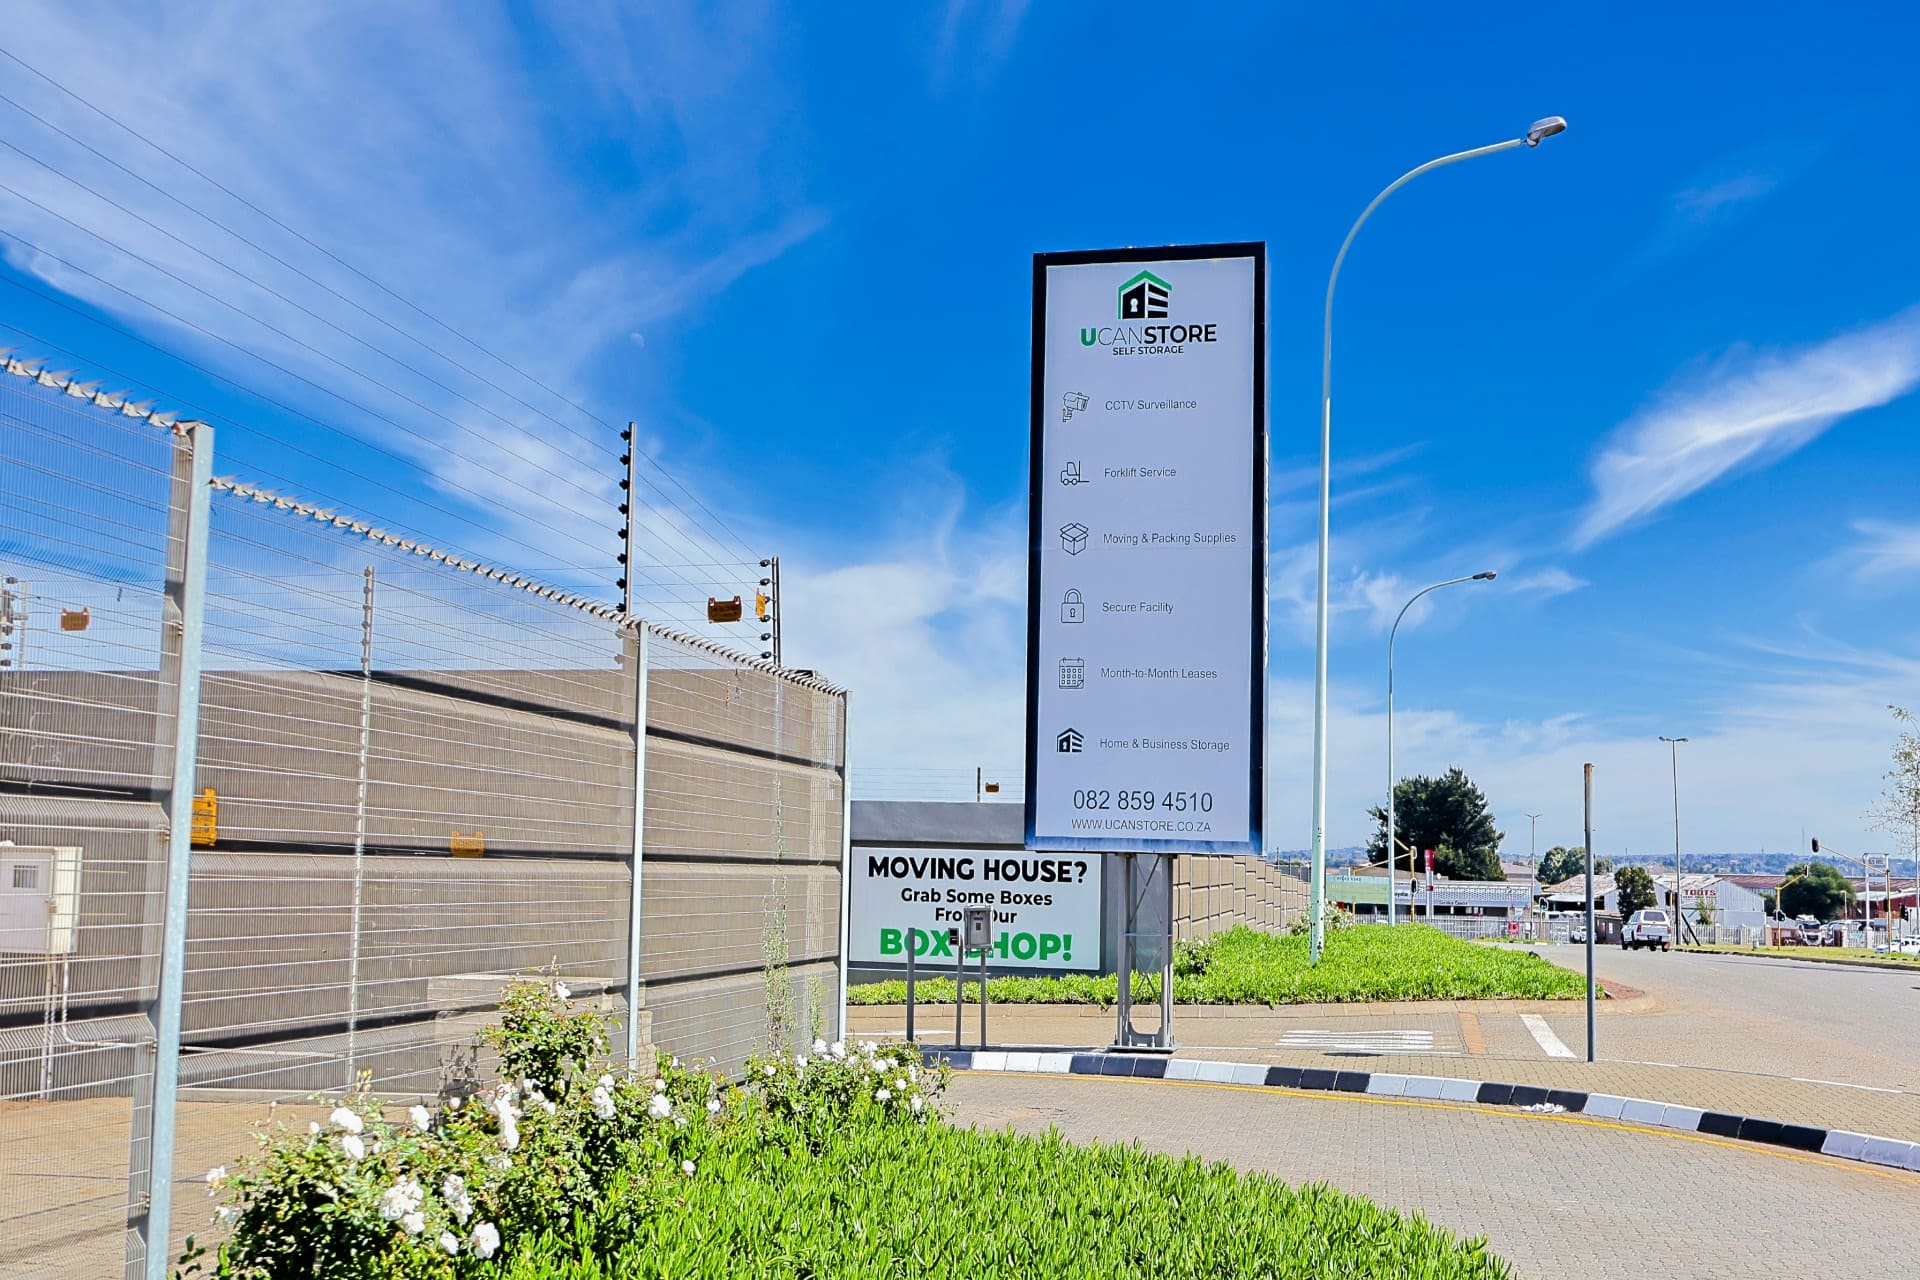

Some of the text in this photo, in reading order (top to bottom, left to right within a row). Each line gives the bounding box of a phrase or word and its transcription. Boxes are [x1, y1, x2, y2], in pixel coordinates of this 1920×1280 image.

[1080, 324, 1217, 347] UCANSTORE
[1112, 344, 1184, 356] SELF STORAGE
[1105, 399, 1197, 411] CCTV Surveillance
[1104, 466, 1177, 478] Forklift Service
[1103, 532, 1237, 546] Moving & Packing Supplies
[1102, 602, 1174, 614] Secure Facility
[1100, 667, 1218, 679] Month-to-Month Leases
[1099, 738, 1230, 753] Home & Business Storage
[1073, 790, 1213, 812] 082 859 4510
[1071, 818, 1212, 833] WWW.UCANSTORE.CO.ZA
[868, 856, 1088, 883] MOVING HOUSE?
[900, 888, 1053, 906] Grab Some Boxes
[935, 907, 962, 922] Fro
[880, 928, 1073, 962] BOX HOP!
